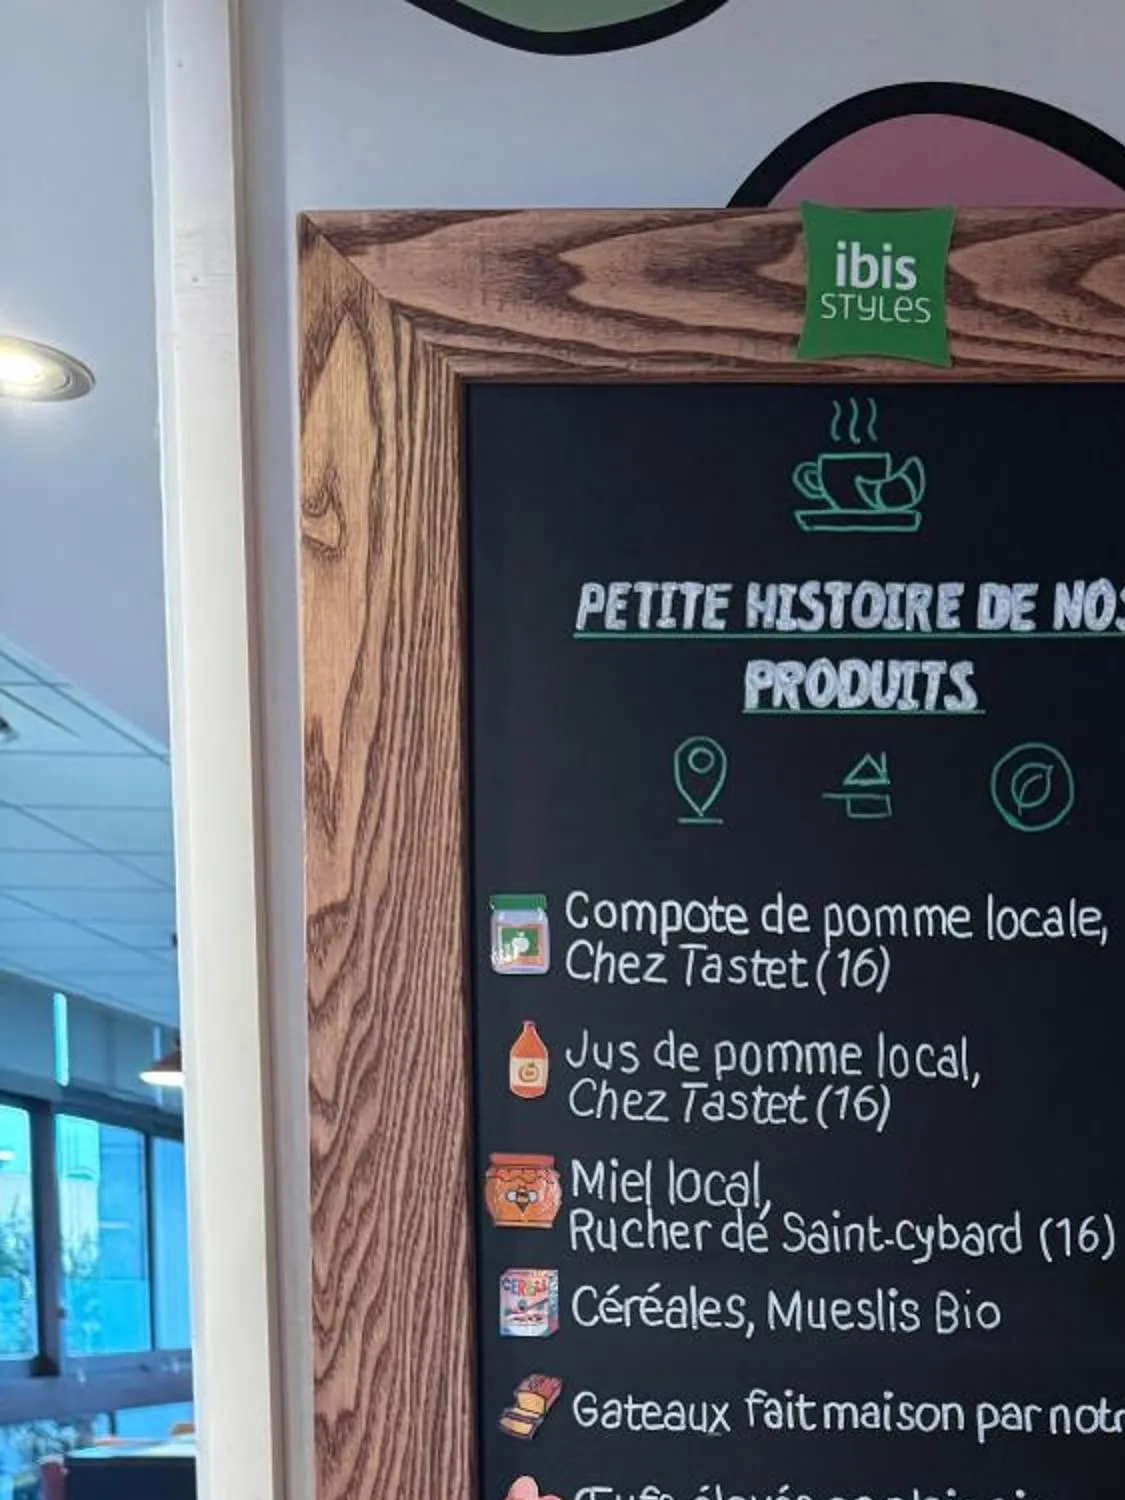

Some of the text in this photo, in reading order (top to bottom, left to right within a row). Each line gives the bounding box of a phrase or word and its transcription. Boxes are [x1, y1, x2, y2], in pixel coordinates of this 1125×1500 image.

[835, 241, 917, 290] ibis
[575, 581, 733, 631] PETITE
[746, 580, 965, 632] HISTOIRE
[977, 582, 1039, 631] DE
[744, 657, 978, 710] PRODUITS
[565, 890, 1108, 947] Compote de pomme locale,
[565, 940, 891, 996] Chez Tastet (16)
[565, 1029, 980, 1090] Jus de pomme local,
[569, 1078, 891, 1133] Chez Tastet (16)
[571, 1157, 772, 1221] Miel local,
[569, 1210, 707, 1253] Rucher
[1039, 1213, 1115, 1263] (16)
[571, 1282, 1001, 1339] Céréales, Mueslis Bio
[572, 1391, 731, 1434] Gateaux
[744, 1388, 817, 1431] fait
[823, 1391, 965, 1433] maison
[976, 1402, 1043, 1444] par
